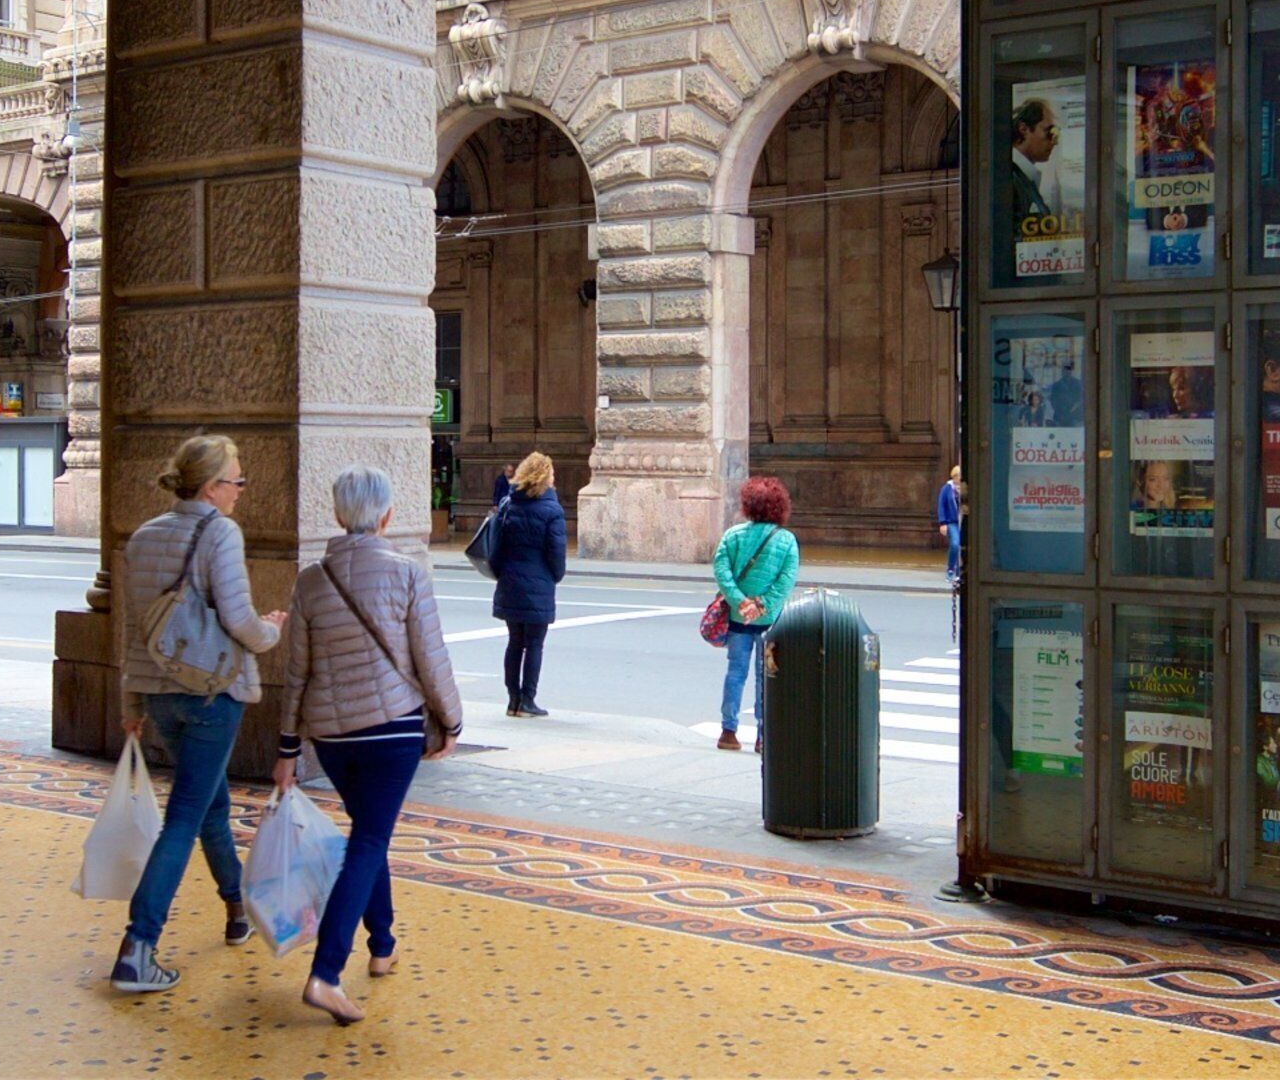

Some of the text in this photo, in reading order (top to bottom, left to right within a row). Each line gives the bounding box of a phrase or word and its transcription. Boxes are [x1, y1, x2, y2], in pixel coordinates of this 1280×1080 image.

[1144, 179, 1210, 198] ODEON
[1018, 258, 1085, 274] CORALL
[1037, 652, 1069, 666] FILM
[1129, 724, 1210, 743] ARISTON
[1131, 749, 1169, 767] SOLE
[1131, 765, 1180, 785] CUORE
[1129, 781, 1187, 806] AMORE
